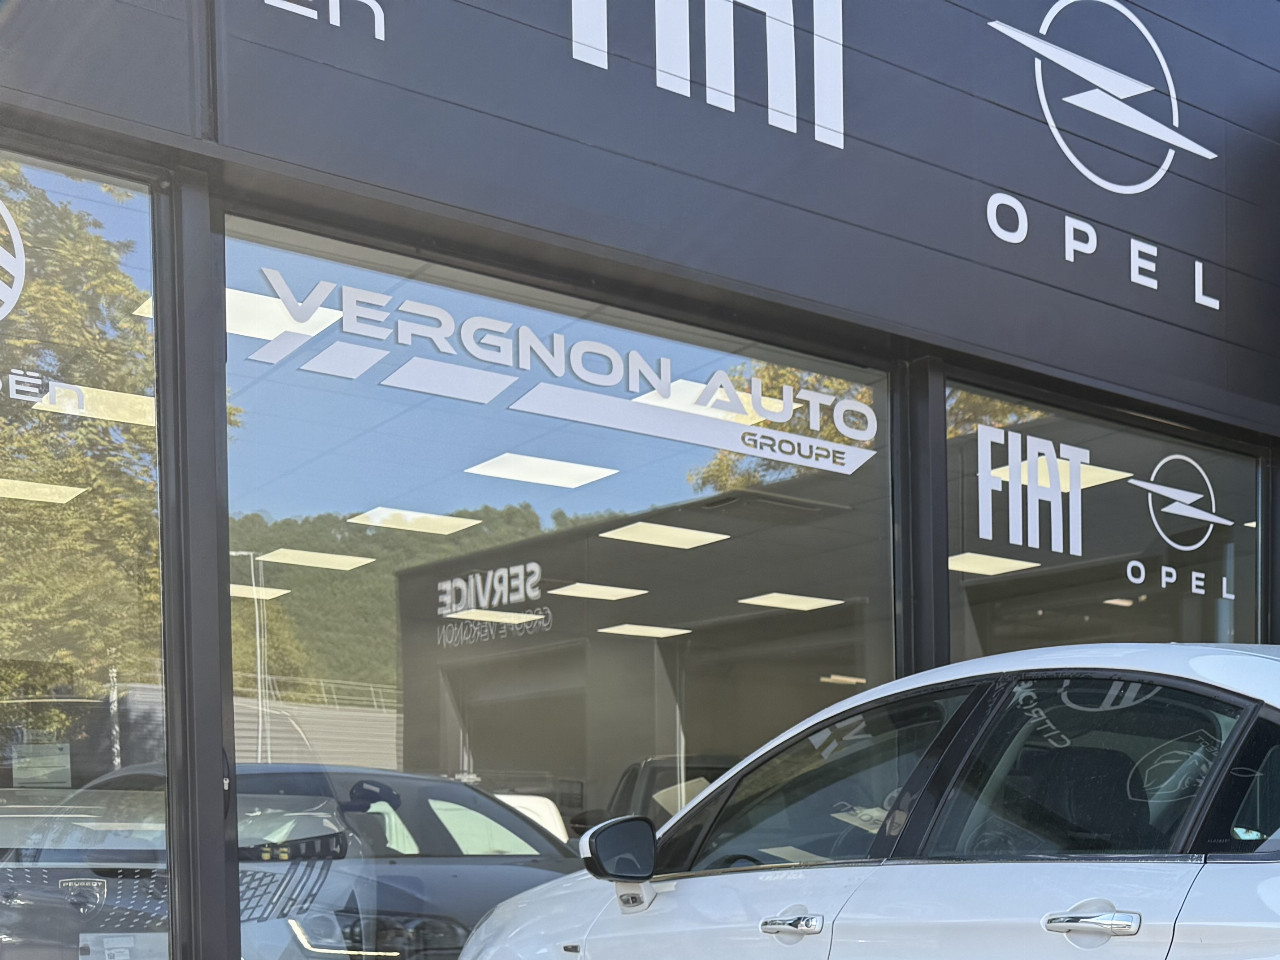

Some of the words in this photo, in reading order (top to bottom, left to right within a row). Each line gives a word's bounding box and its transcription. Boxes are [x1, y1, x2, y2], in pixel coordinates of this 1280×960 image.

[986, 192, 1220, 310] OPEL
[261, 267, 671, 399] VERGNON
[694, 370, 878, 442] AUTO
[740, 431, 846, 467] GROUPE
[977, 424, 1091, 557] FIAT
[1126, 560, 1235, 600] OPEL
